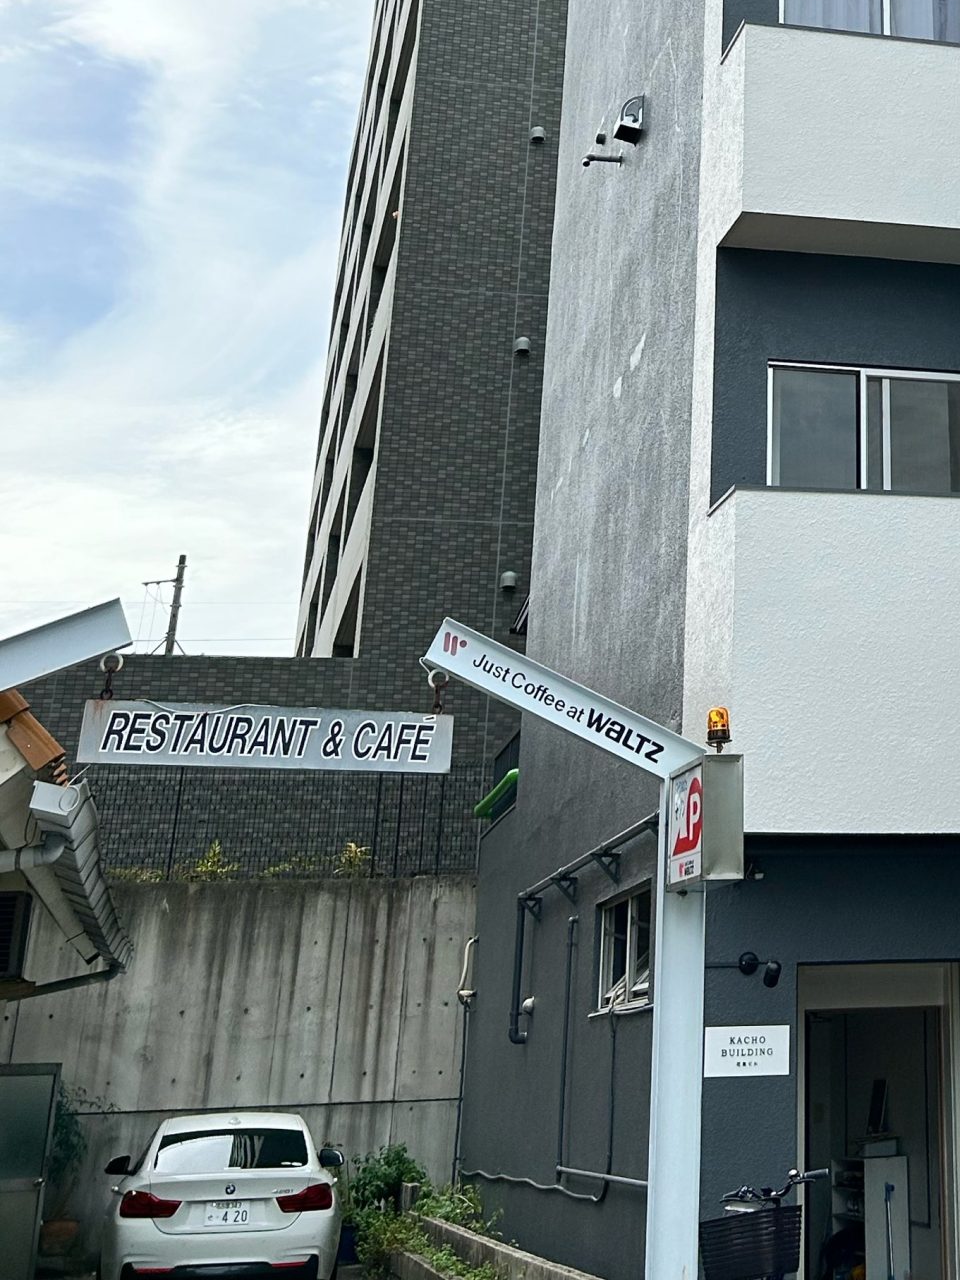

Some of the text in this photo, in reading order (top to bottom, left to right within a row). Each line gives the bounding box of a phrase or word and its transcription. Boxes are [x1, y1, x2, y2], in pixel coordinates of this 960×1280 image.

[473, 654, 512, 683] Just
[511, 672, 566, 712] Coffee
[566, 704, 585, 723] at
[100, 711, 437, 763] RESTAURANT & CAFÉ
[689, 792, 701, 840] P
[721, 1048, 774, 1057] BUILDING
[729, 1036, 766, 1045] KACHO
